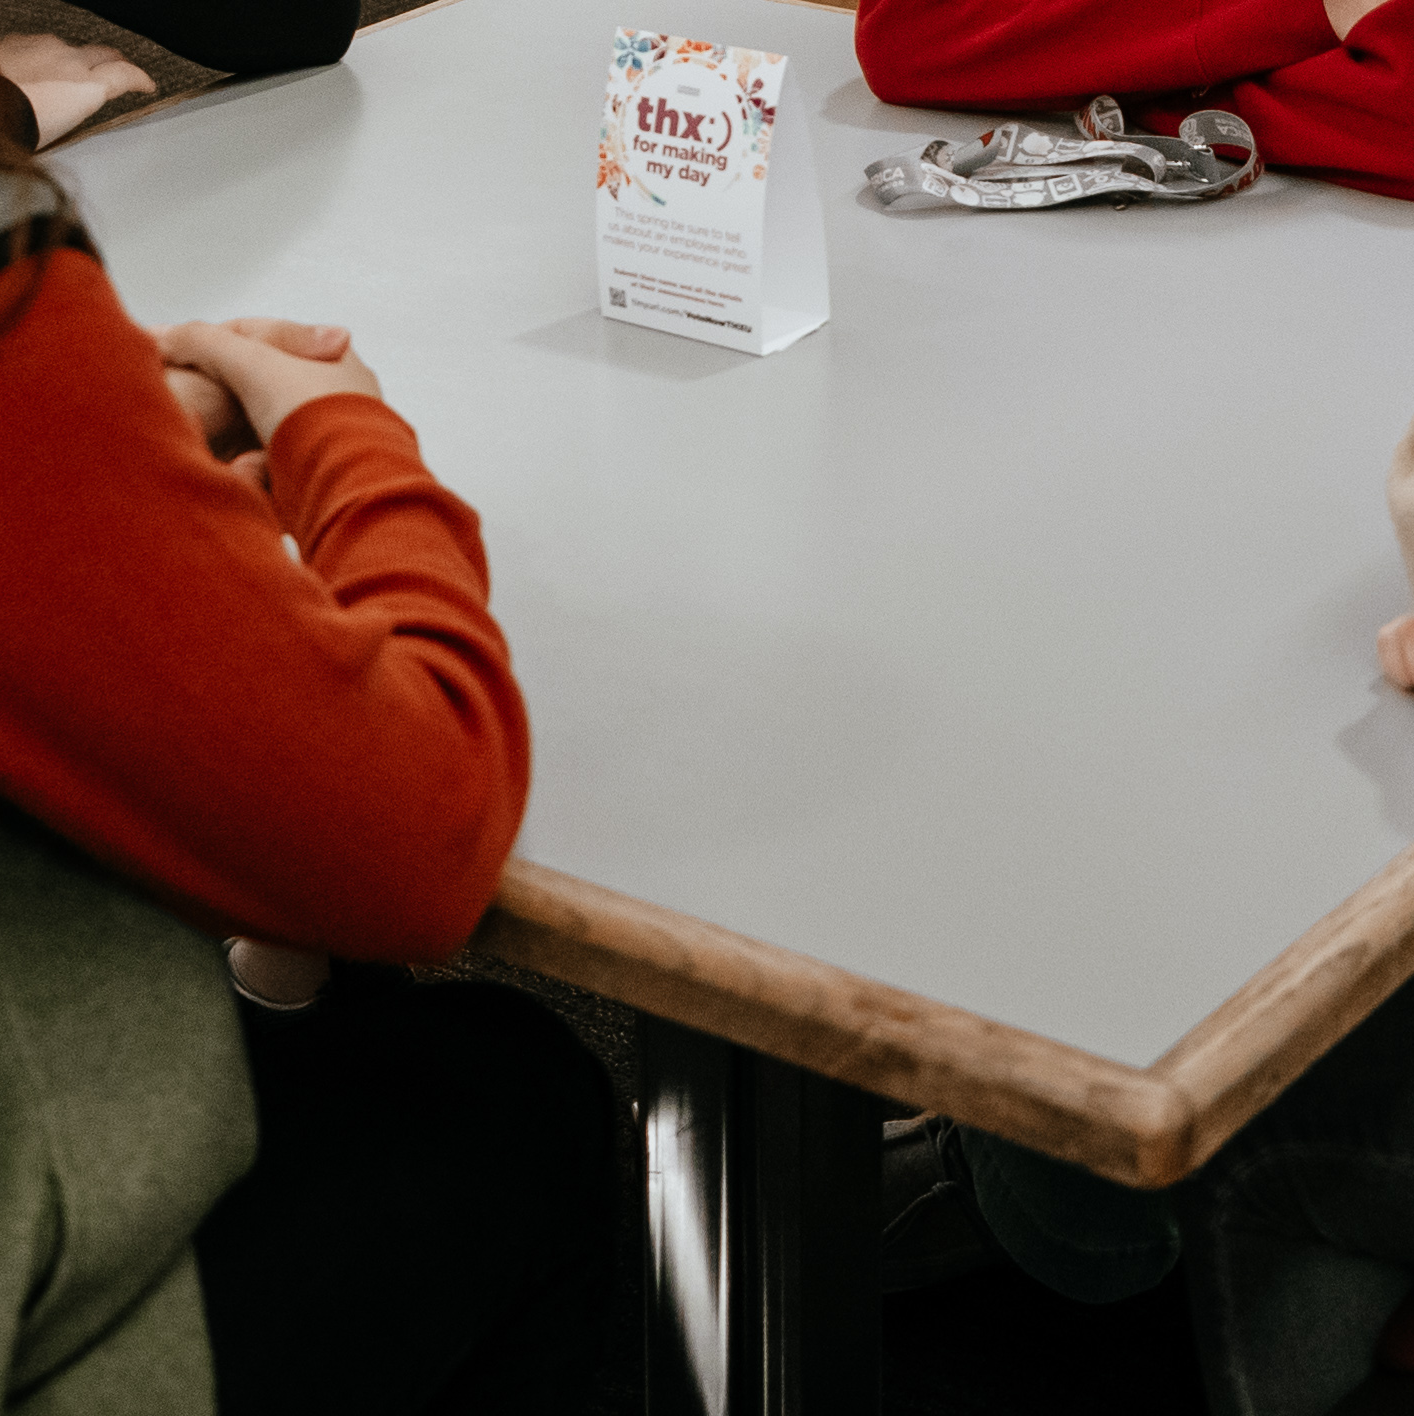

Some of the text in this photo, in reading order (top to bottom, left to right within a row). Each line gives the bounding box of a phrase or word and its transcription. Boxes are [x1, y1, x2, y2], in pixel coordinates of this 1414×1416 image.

[636, 96, 732, 153] thx:)
[632, 134, 728, 172] for making
[646, 160, 711, 188] my day
